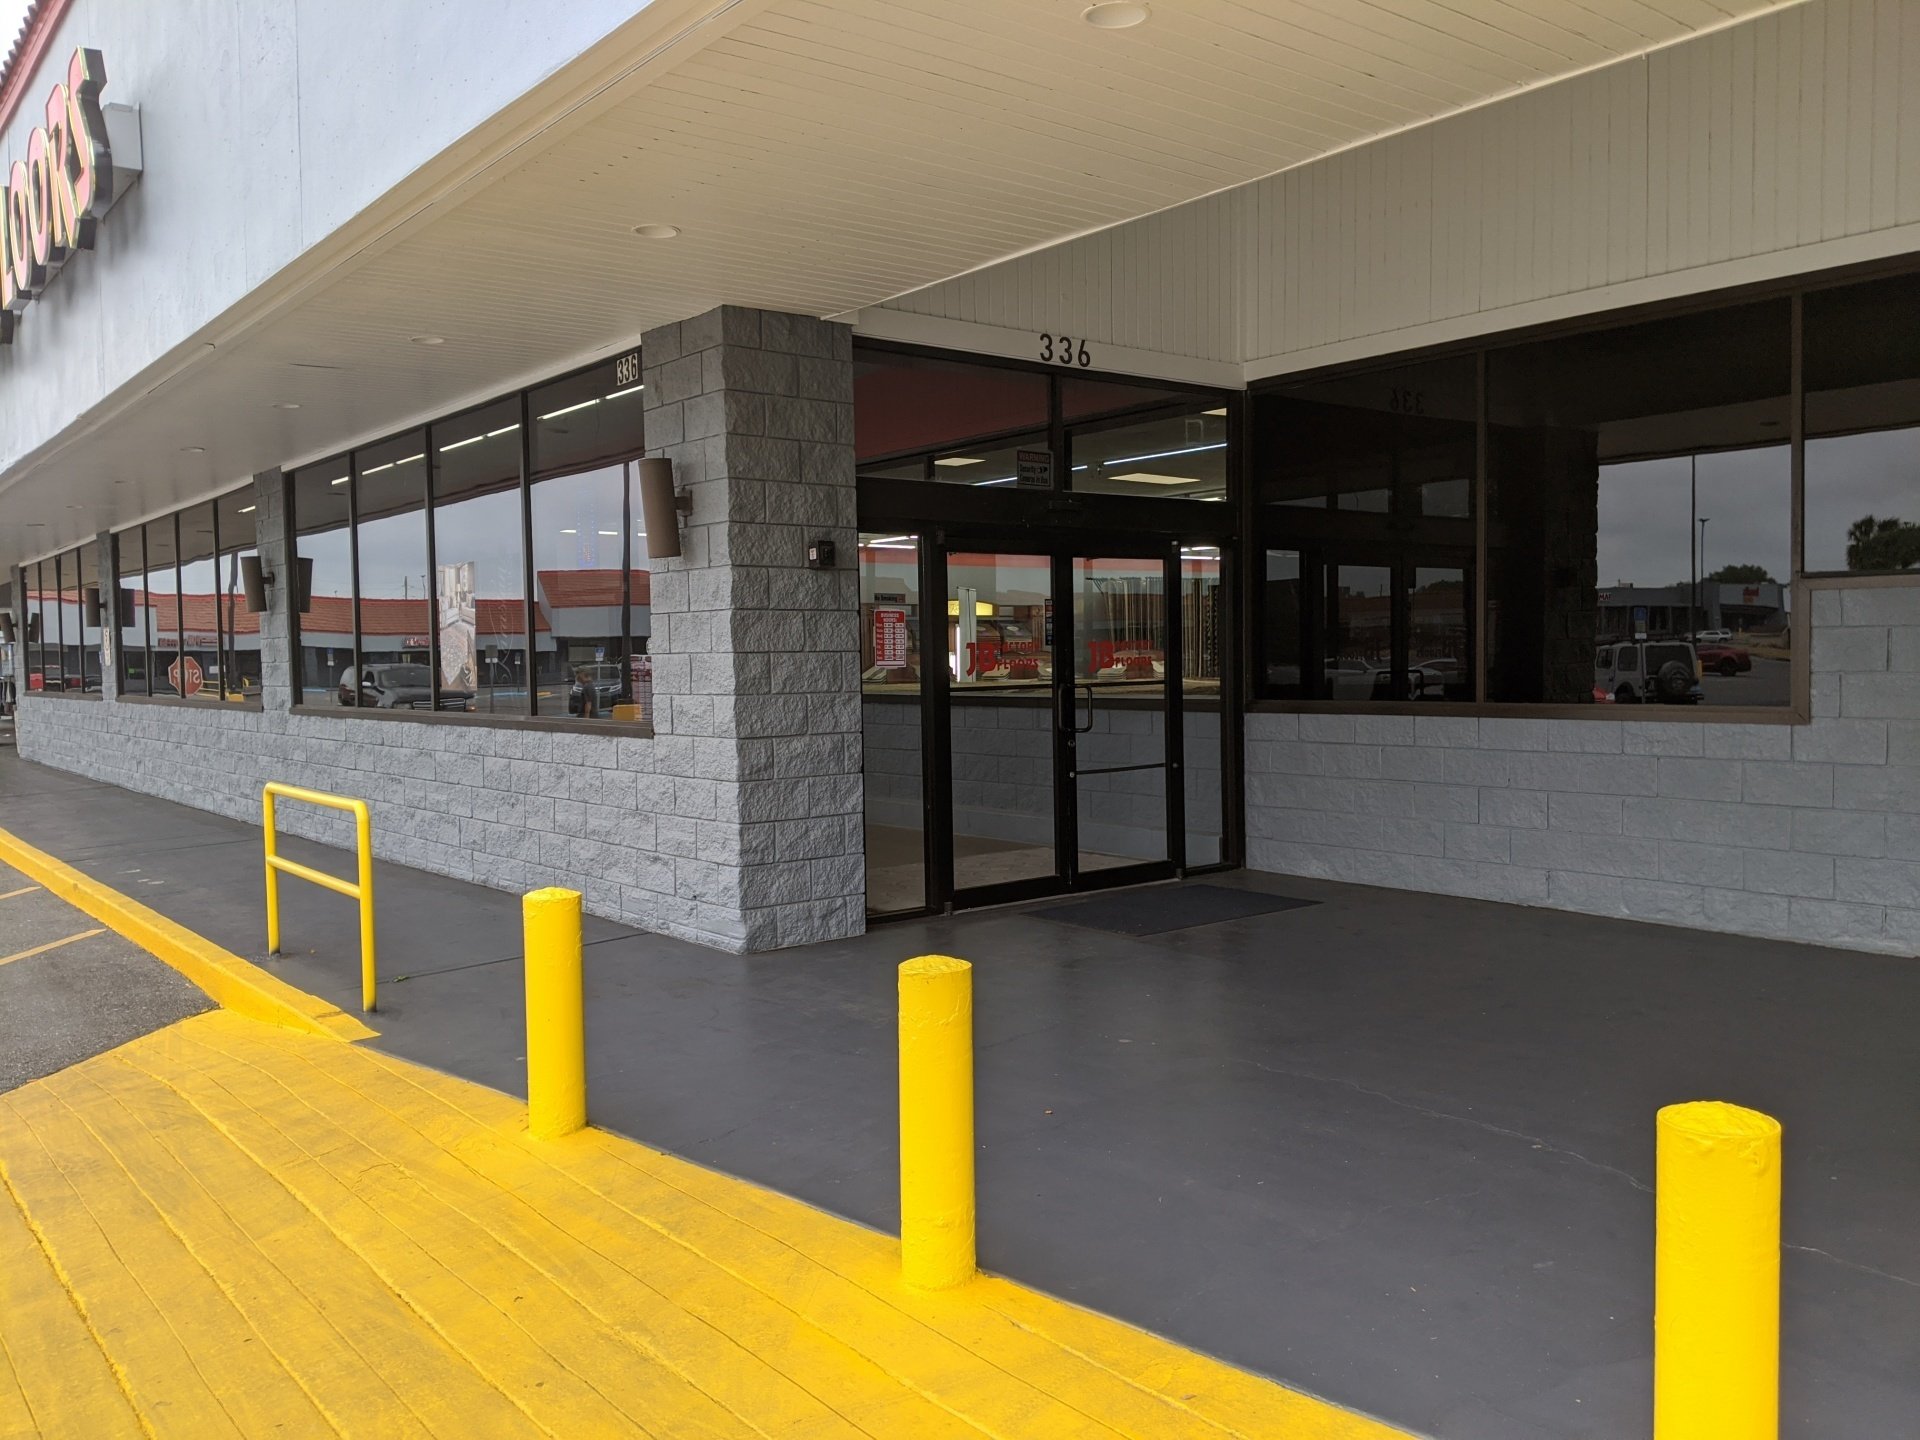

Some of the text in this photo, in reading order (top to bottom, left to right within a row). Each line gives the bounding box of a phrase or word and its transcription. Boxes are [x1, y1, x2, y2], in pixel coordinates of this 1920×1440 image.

[1040, 333, 1091, 367] 336
[617, 353, 638, 384] 336
[1019, 451, 1050, 463] WARNING
[994, 658, 1038, 671] FLOORS
[1113, 656, 1152, 668] FLOORS
